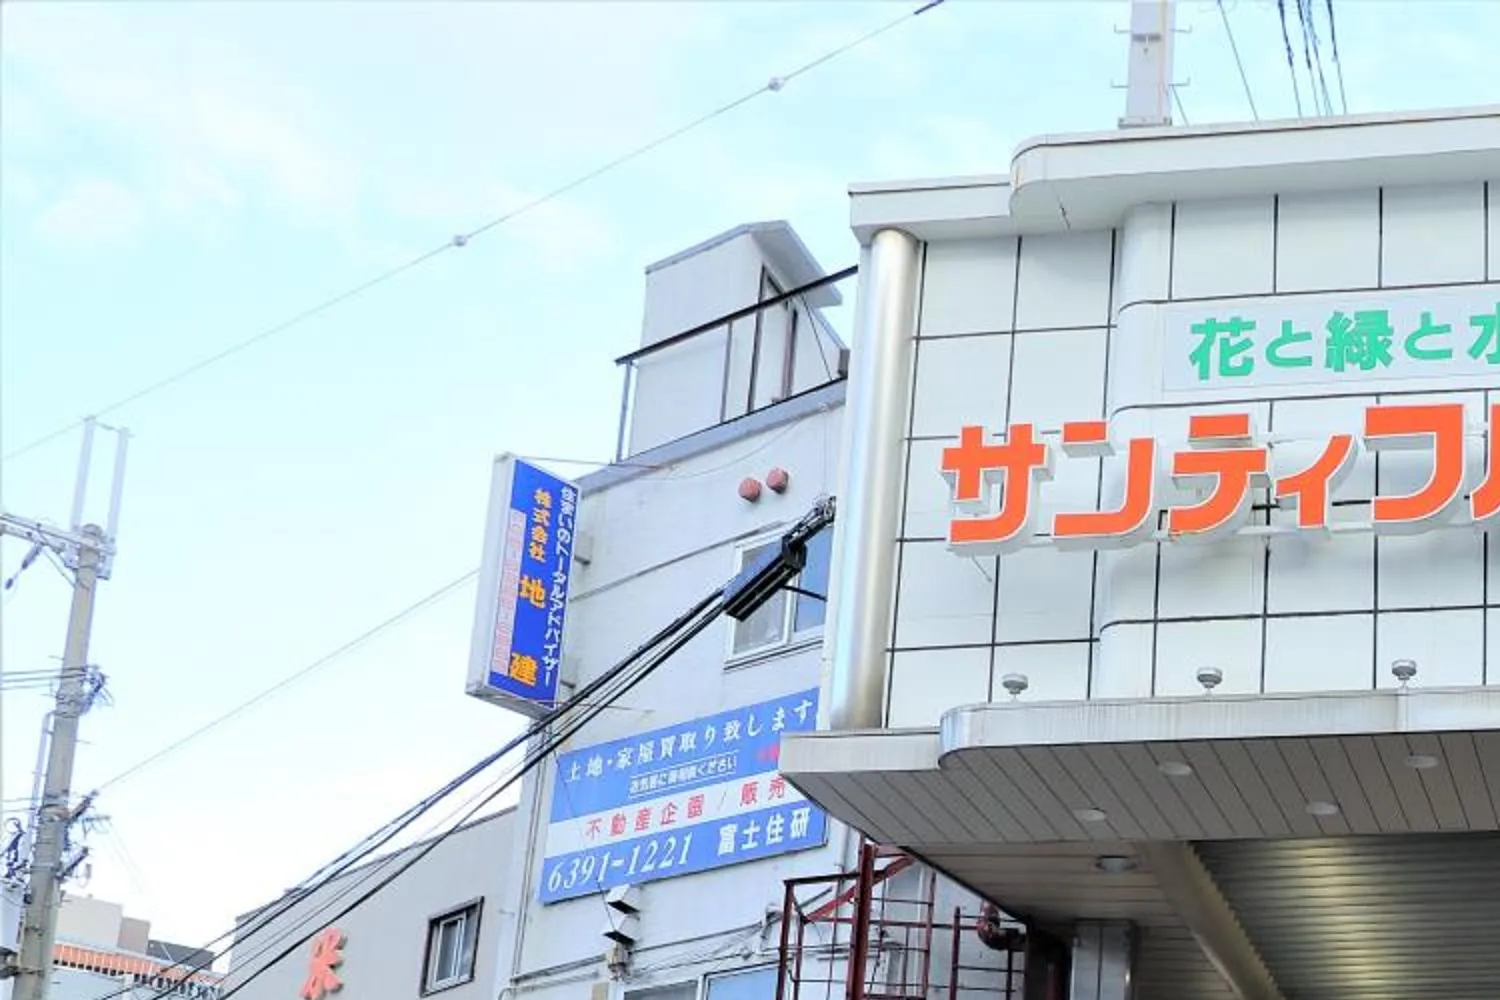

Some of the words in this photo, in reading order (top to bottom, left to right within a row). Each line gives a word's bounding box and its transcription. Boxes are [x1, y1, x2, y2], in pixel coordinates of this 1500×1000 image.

[528, 487, 552, 564] 株式会社
[546, 831, 695, 894] 6391-1221
[716, 805, 811, 857] 富士住研
